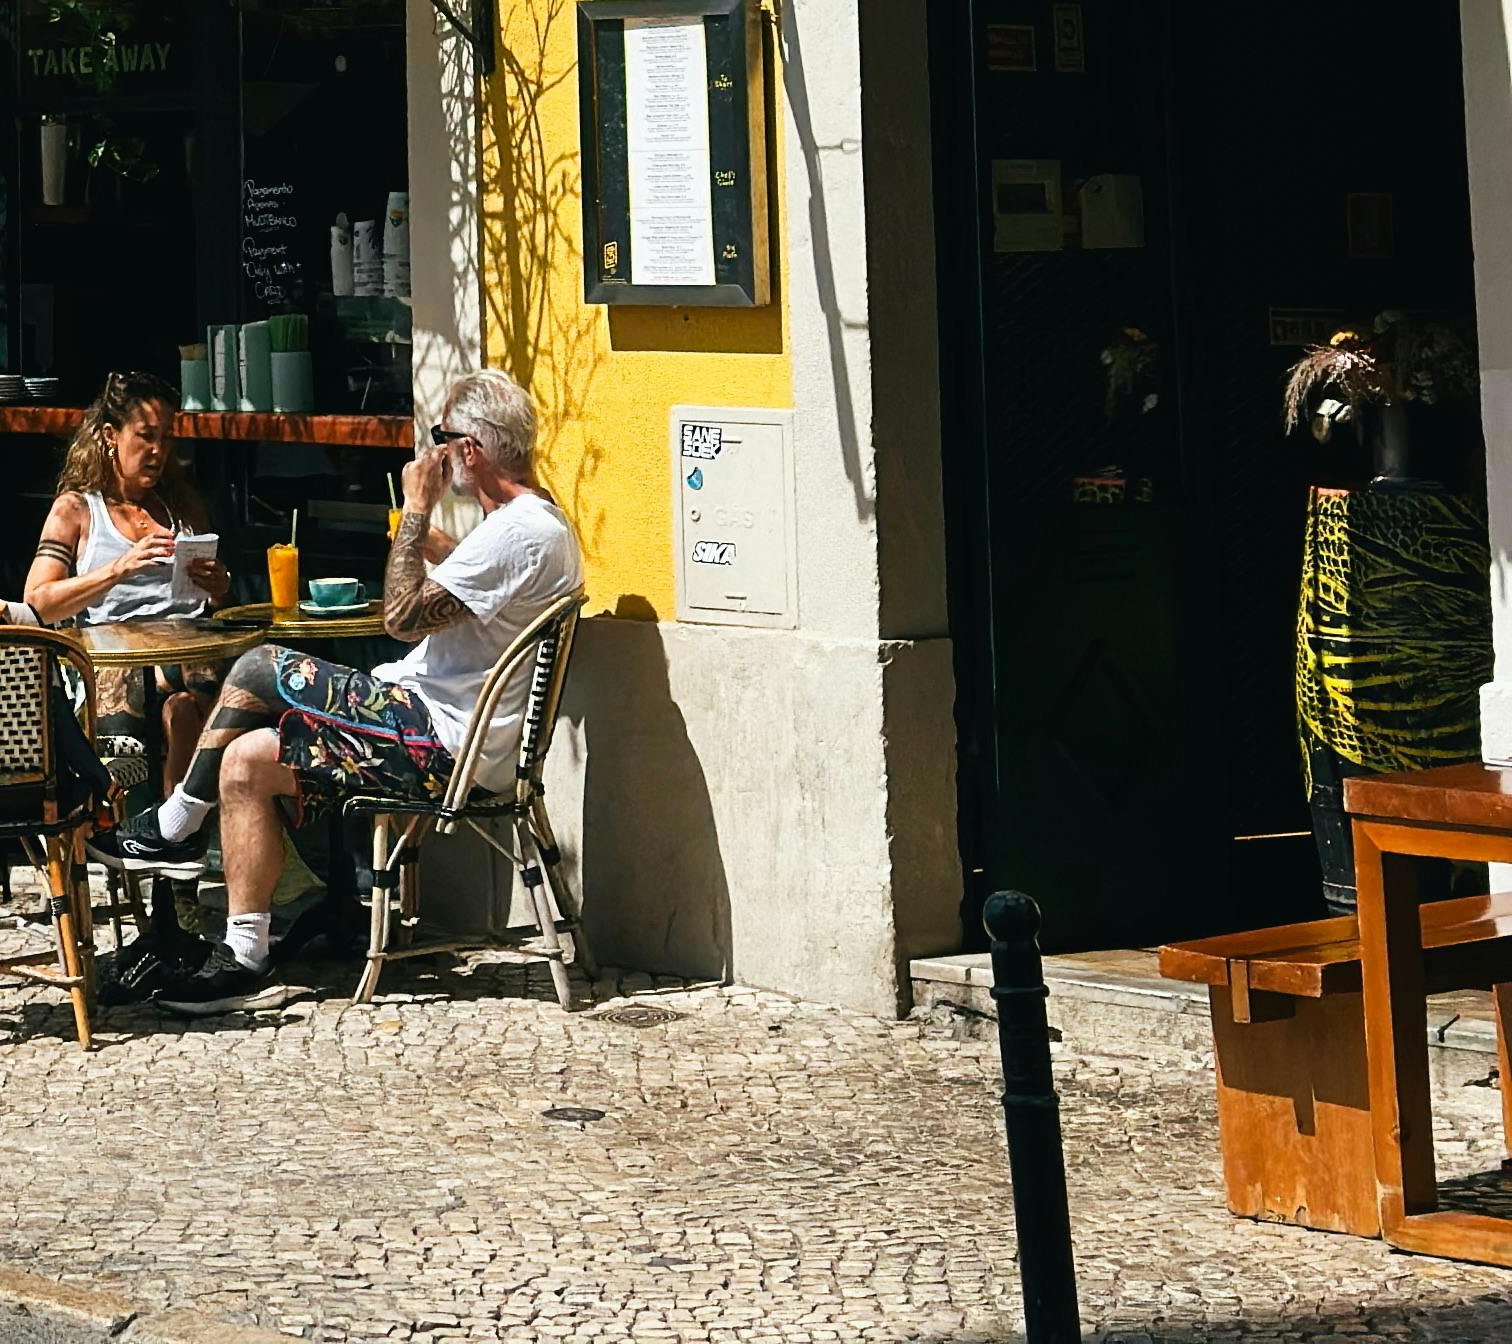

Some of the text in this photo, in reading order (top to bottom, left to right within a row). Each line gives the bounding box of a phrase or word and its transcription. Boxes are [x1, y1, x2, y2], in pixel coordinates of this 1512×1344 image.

[27, 41, 171, 76] TAKE AWAY
[713, 505, 756, 529] GAS
